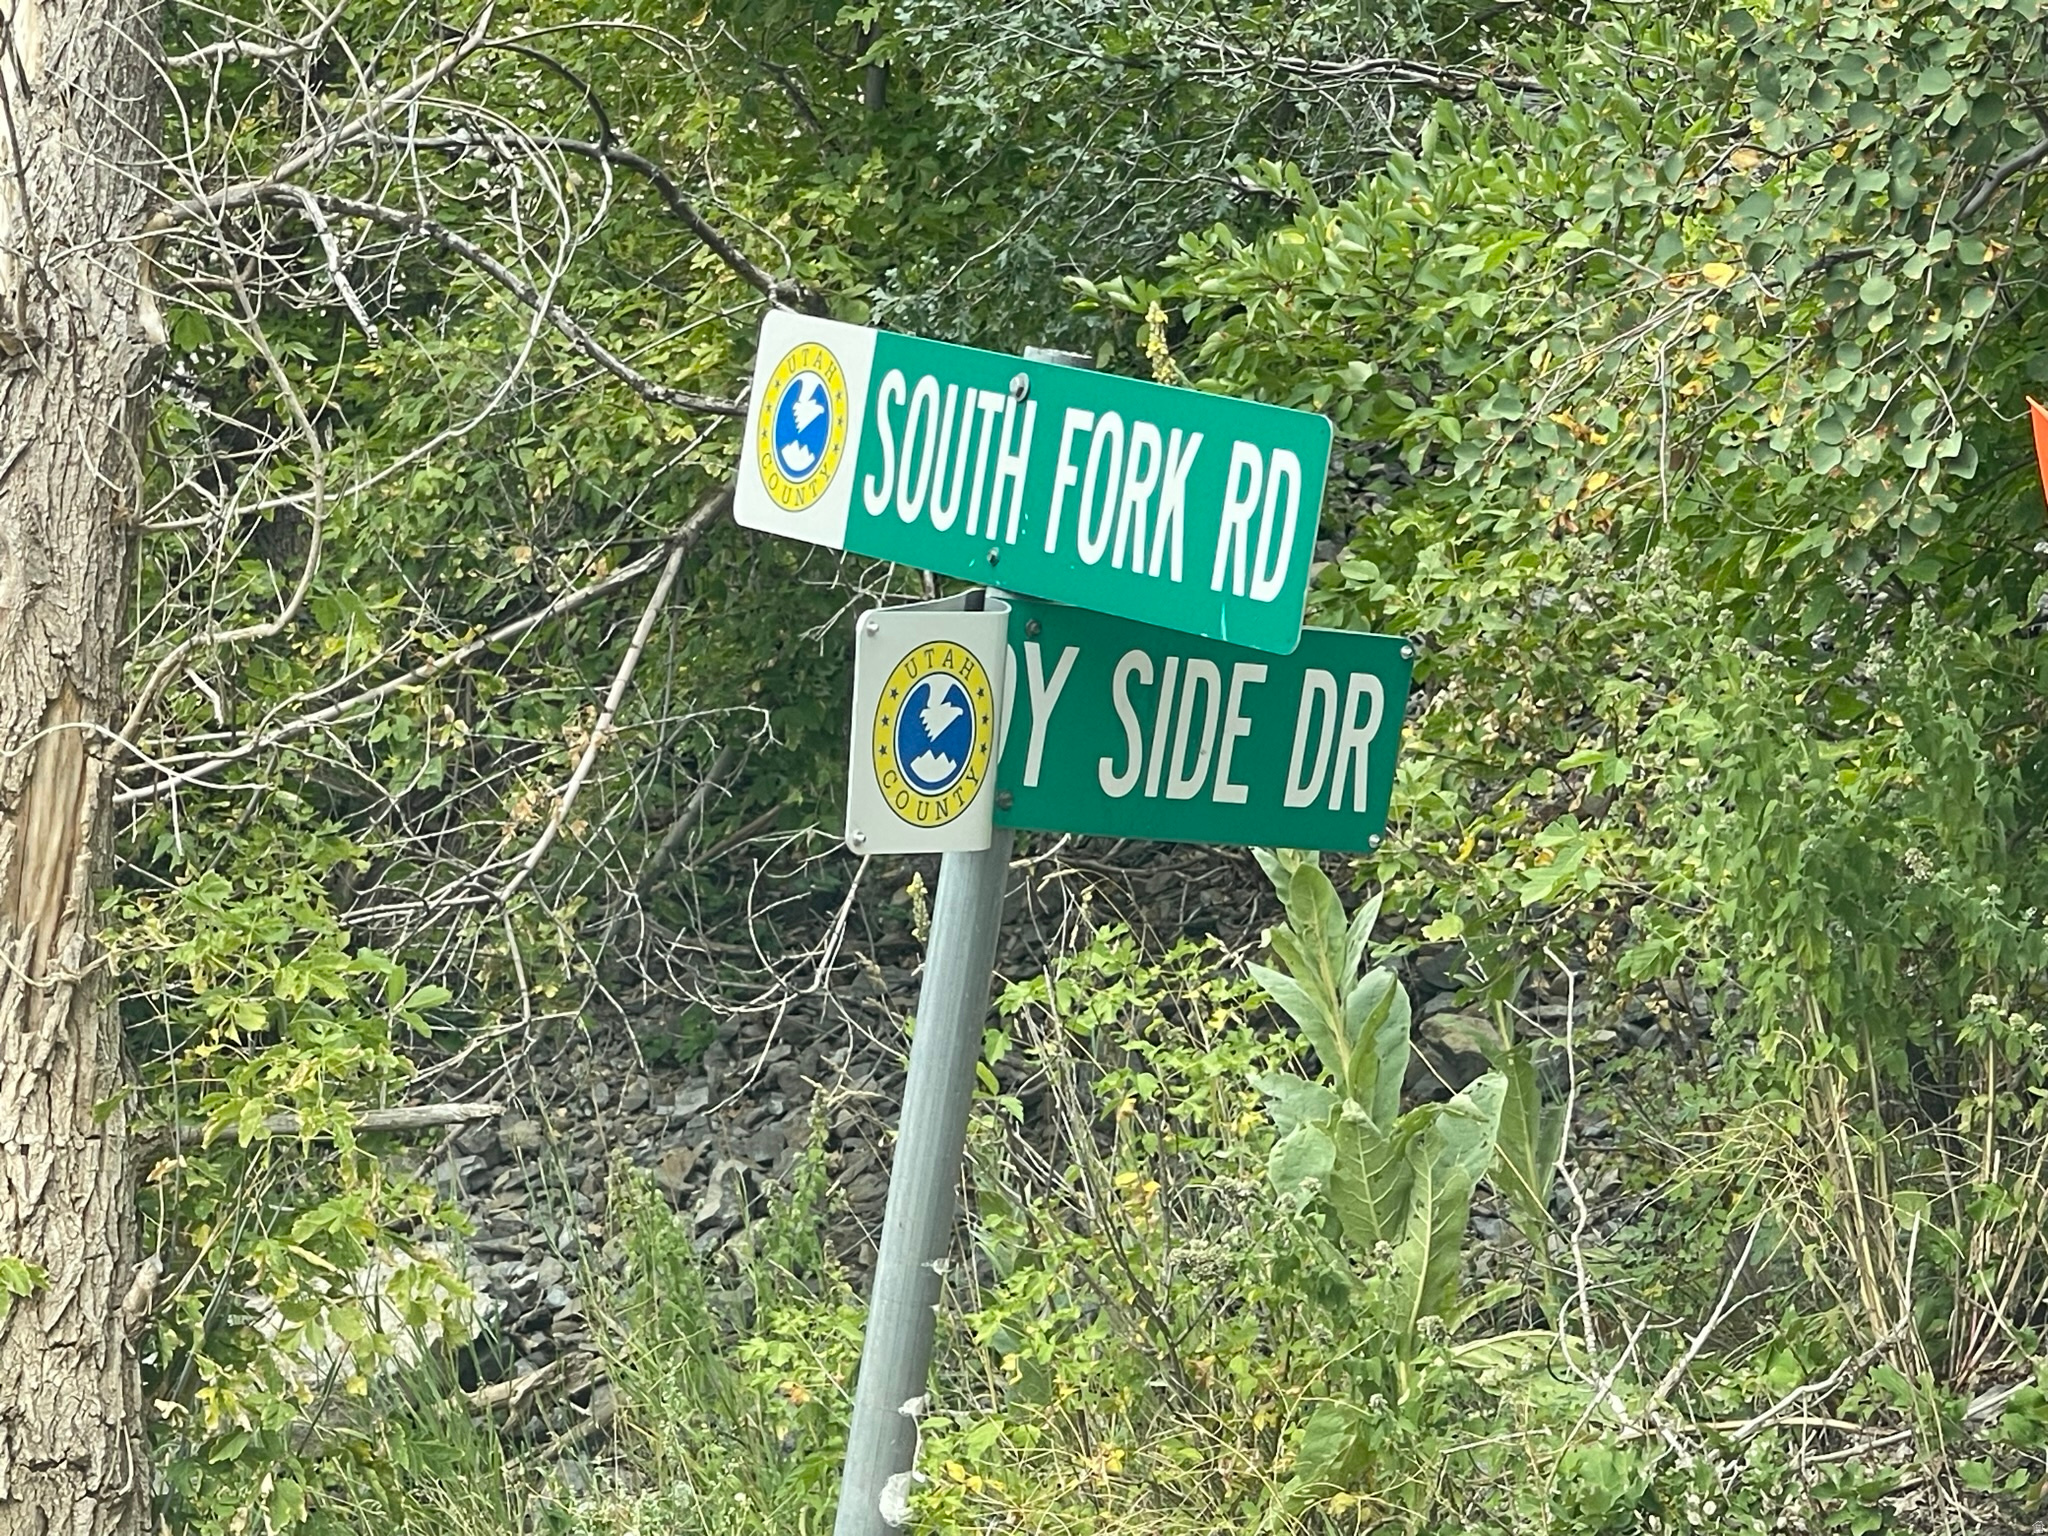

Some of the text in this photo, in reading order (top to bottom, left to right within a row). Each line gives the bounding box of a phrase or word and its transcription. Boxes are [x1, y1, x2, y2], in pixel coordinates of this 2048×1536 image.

[787, 349, 837, 382] UTAH
[760, 452, 831, 507] COUNTY
[863, 368, 1302, 602] SOUTH FORK RD
[904, 648, 977, 682] UTAH
[1098, 649, 1267, 805] SIDE
[1284, 668, 1384, 813] DR
[882, 766, 980, 821] COUNTY
